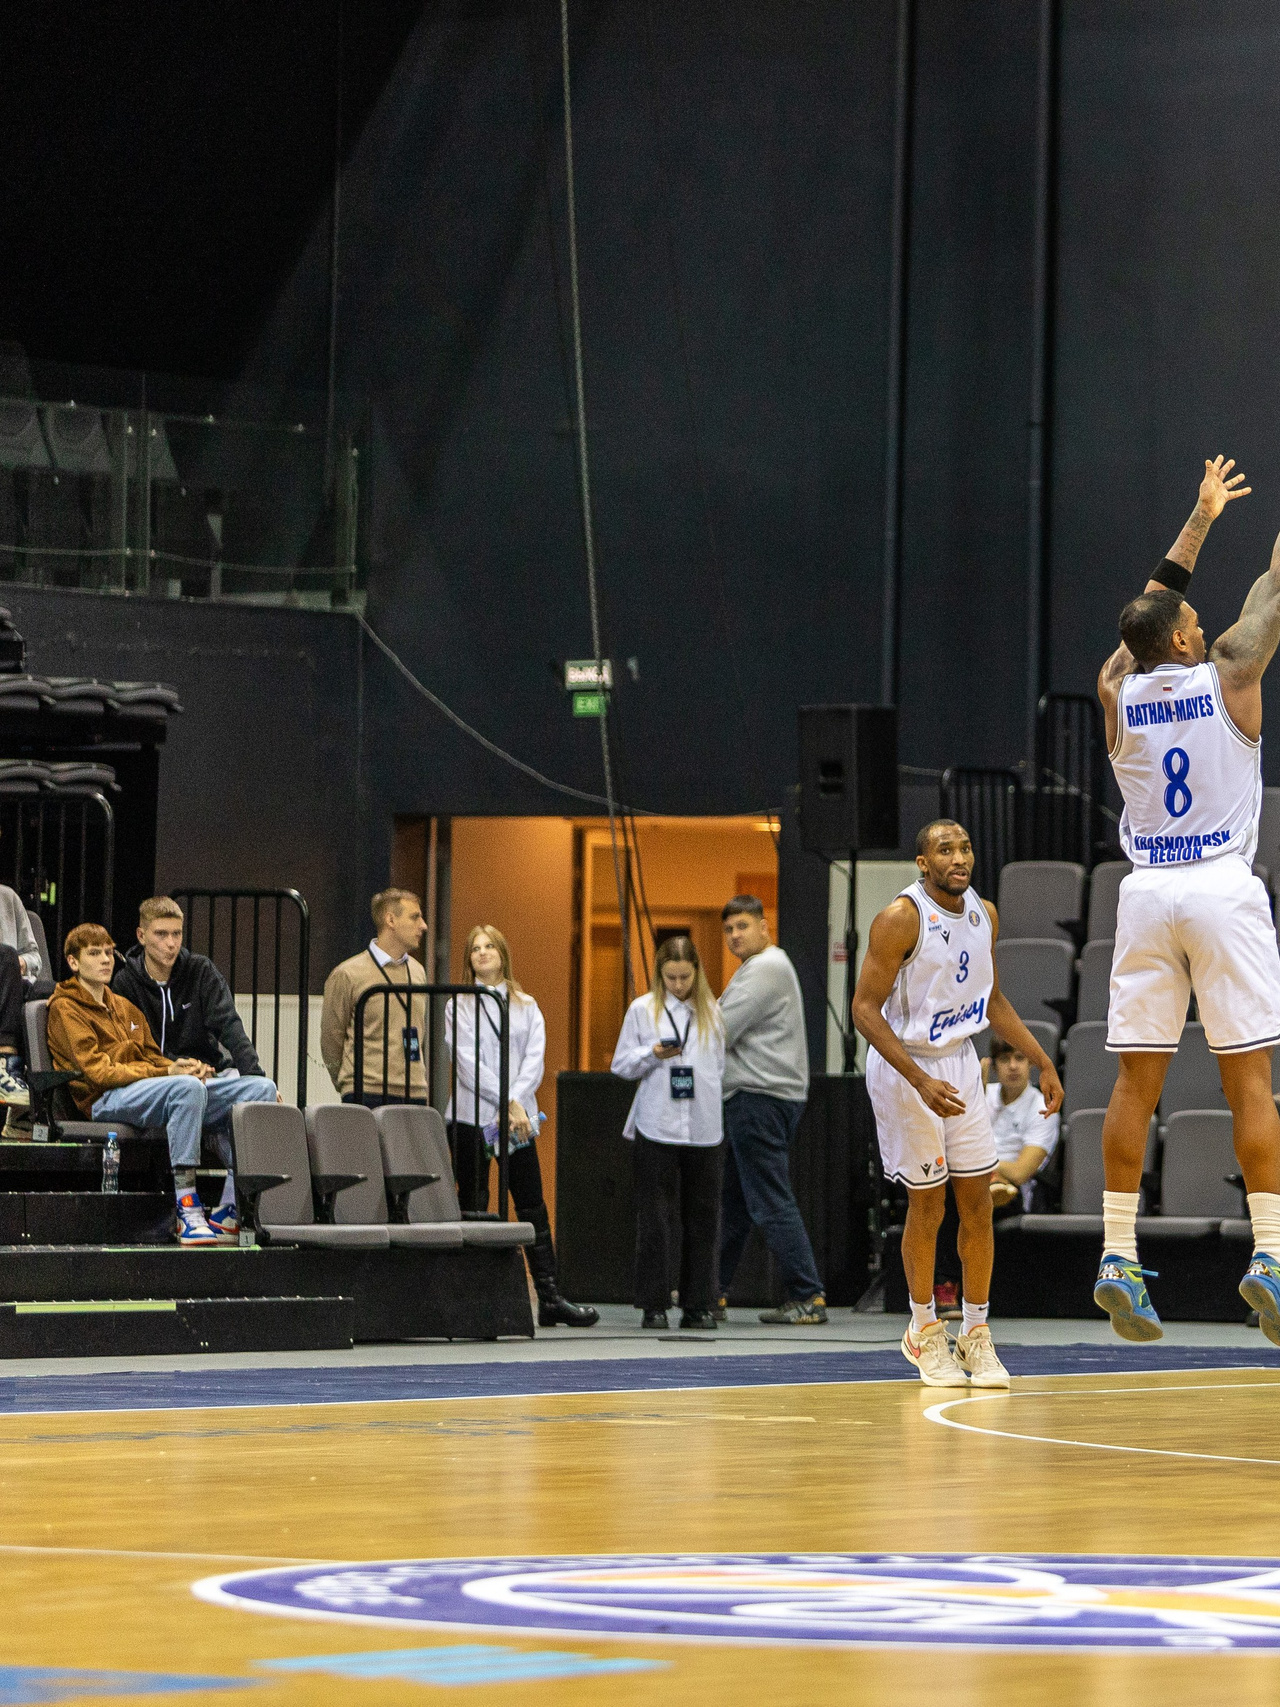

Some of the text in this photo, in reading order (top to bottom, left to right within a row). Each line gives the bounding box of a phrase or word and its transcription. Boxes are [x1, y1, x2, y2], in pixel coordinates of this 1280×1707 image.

[1125, 693, 1215, 728] RATHAN-MAYES
[1161, 746, 1193, 818] 8
[1133, 829, 1232, 852] KRASNOYARSK
[1149, 846, 1203, 865] REGION
[955, 950, 970, 984] 3
